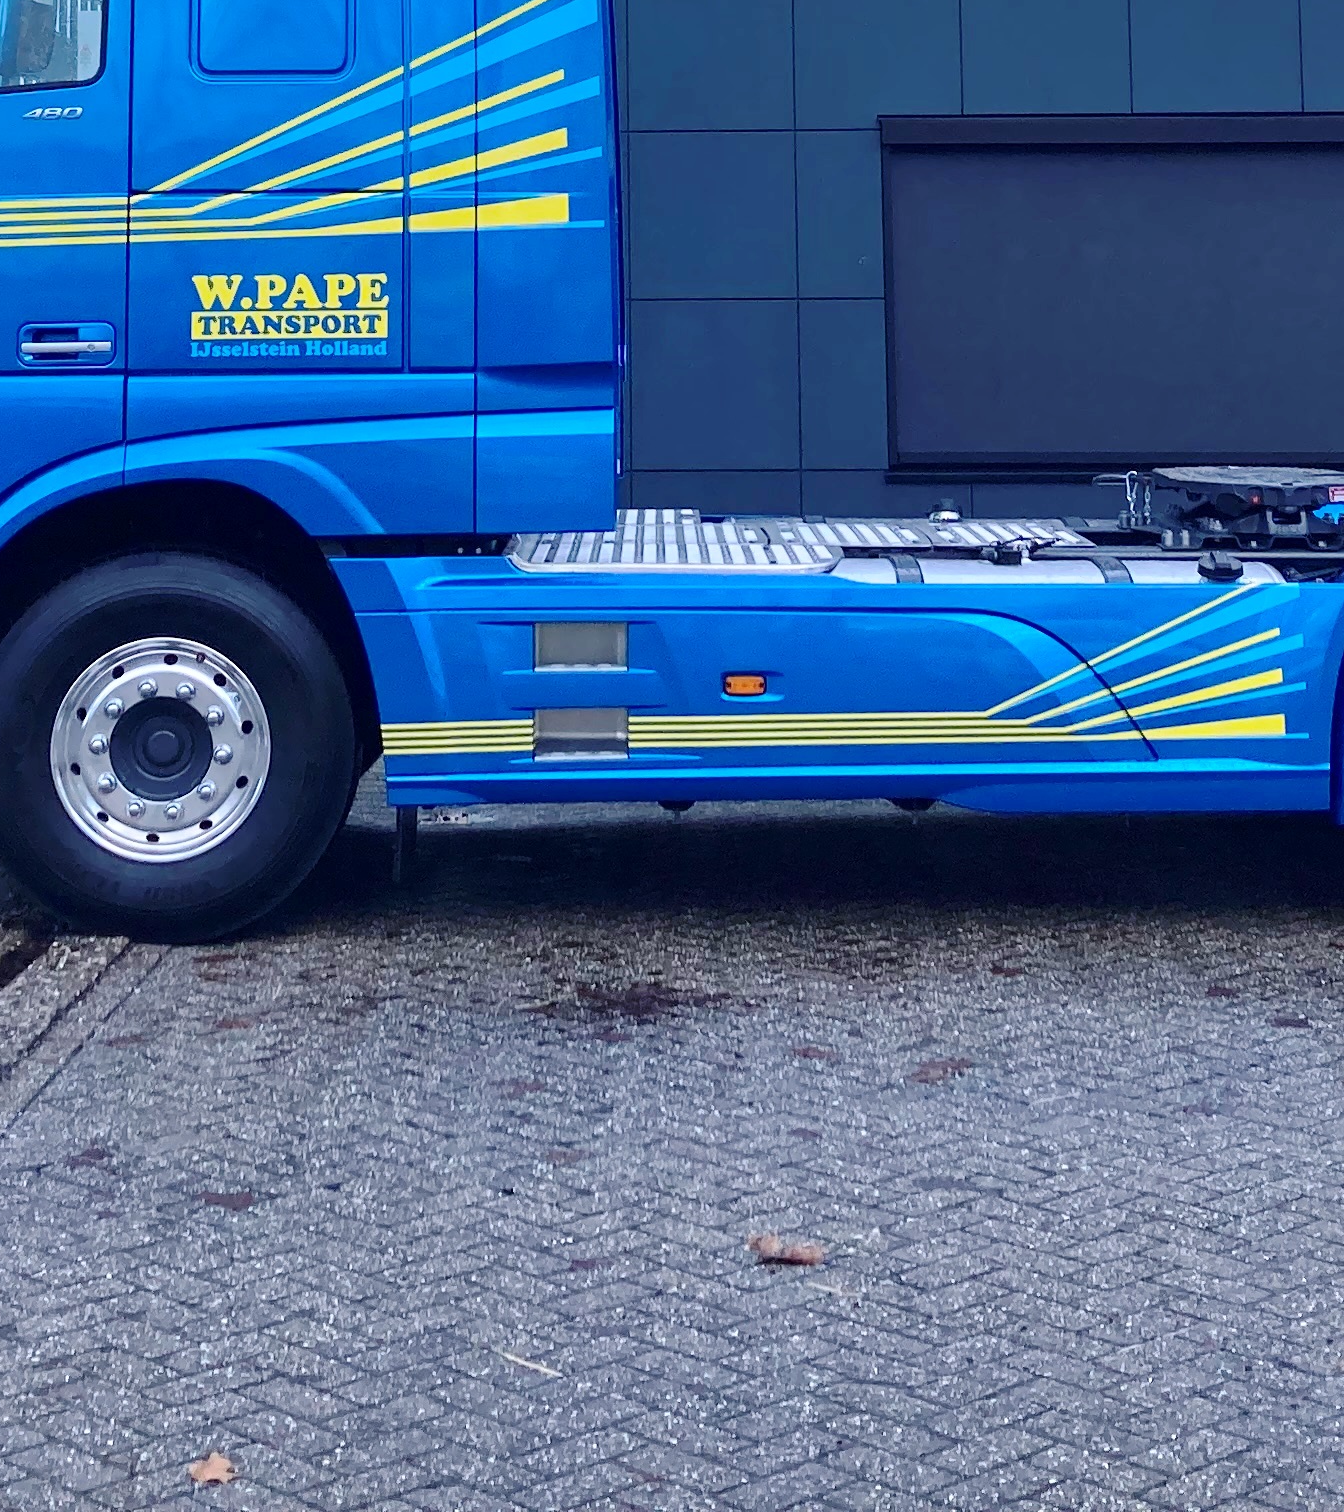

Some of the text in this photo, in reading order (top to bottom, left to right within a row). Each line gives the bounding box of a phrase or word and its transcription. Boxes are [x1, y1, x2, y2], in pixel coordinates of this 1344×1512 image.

[22, 106, 83, 120] 480
[191, 273, 390, 310] W.PAPE
[197, 314, 382, 335] TRANSPORT
[190, 340, 388, 357] IJsselstein Holland
